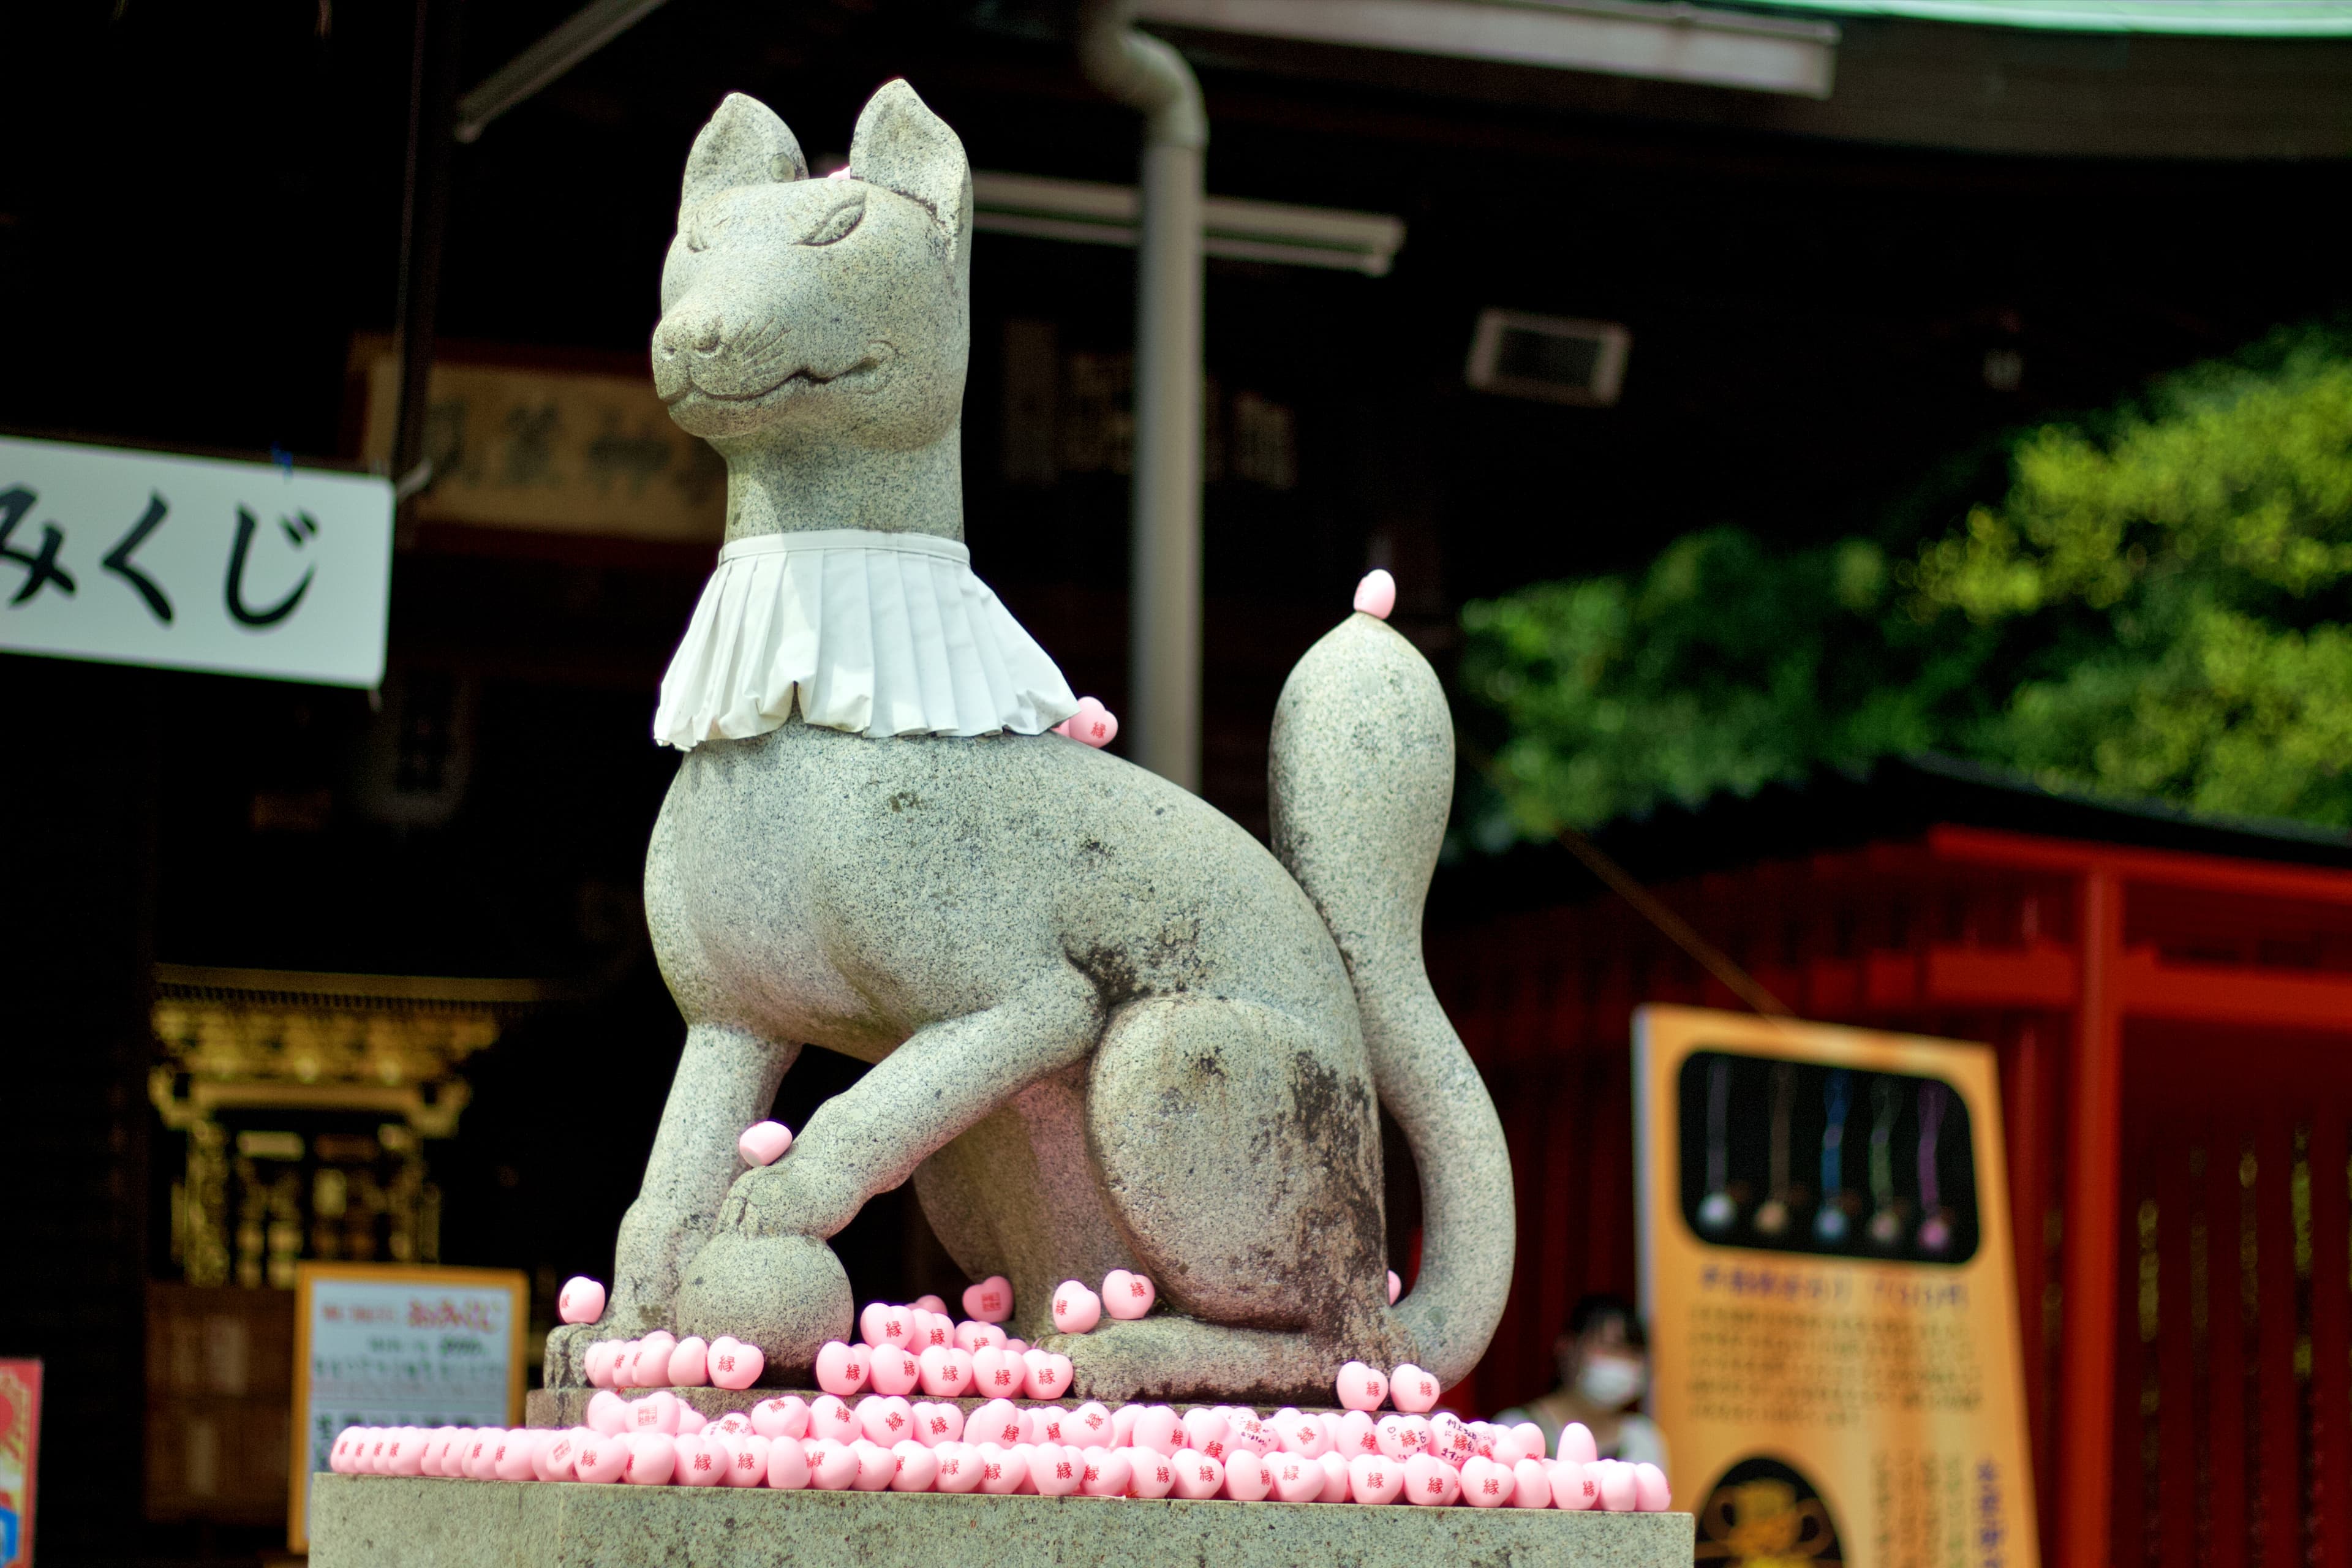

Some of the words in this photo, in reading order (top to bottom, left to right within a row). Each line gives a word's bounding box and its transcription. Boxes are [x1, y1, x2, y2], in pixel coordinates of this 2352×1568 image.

[1130, 1281, 1146, 1298] 縁
[1056, 1298, 1068, 1316] 縁
[886, 1321, 903, 1338] 縁
[930, 1328, 944, 1344] 縁
[718, 1355, 736, 1373] 縁
[845, 1363, 861, 1381] 縁
[903, 1360, 916, 1377] 縁
[942, 1365, 959, 1382] 縁
[995, 1369, 1011, 1386] 縁
[1038, 1368, 1055, 1385] 縁
[1366, 1381, 1380, 1397] 縁
[1419, 1381, 1433, 1397] 縁
[768, 1399, 788, 1414] 縁
[835, 1406, 851, 1424] 縁
[886, 1411, 905, 1431] 縁
[930, 1416, 949, 1435] 縁
[1085, 1412, 1104, 1431] 縁
[1001, 1423, 1020, 1442] 縁
[1047, 1422, 1061, 1441] 縁
[1170, 1428, 1184, 1447] 縁
[1297, 1426, 1316, 1446] 縁
[1400, 1429, 1419, 1448] 縁
[1204, 1440, 1223, 1458] 縁
[1360, 1431, 1377, 1451] 縁
[1453, 1434, 1468, 1451] 縁
[581, 1449, 598, 1467] 縁
[693, 1453, 712, 1471] 縁
[737, 1452, 755, 1470] 縁
[812, 1450, 826, 1468] 縁
[941, 1458, 959, 1475] 縁
[984, 1463, 1001, 1480] 縁
[1056, 1461, 1073, 1480] 縁
[1083, 1464, 1100, 1481] 縁
[1156, 1466, 1170, 1483] 縁
[1199, 1464, 1215, 1482] 縁
[1261, 1469, 1273, 1486] 縁
[1283, 1464, 1299, 1481] 縁
[1366, 1471, 1384, 1489] 縁
[1427, 1476, 1443, 1494] 縁
[1482, 1477, 1499, 1496] 縁
[1582, 1480, 1596, 1498] 縁
